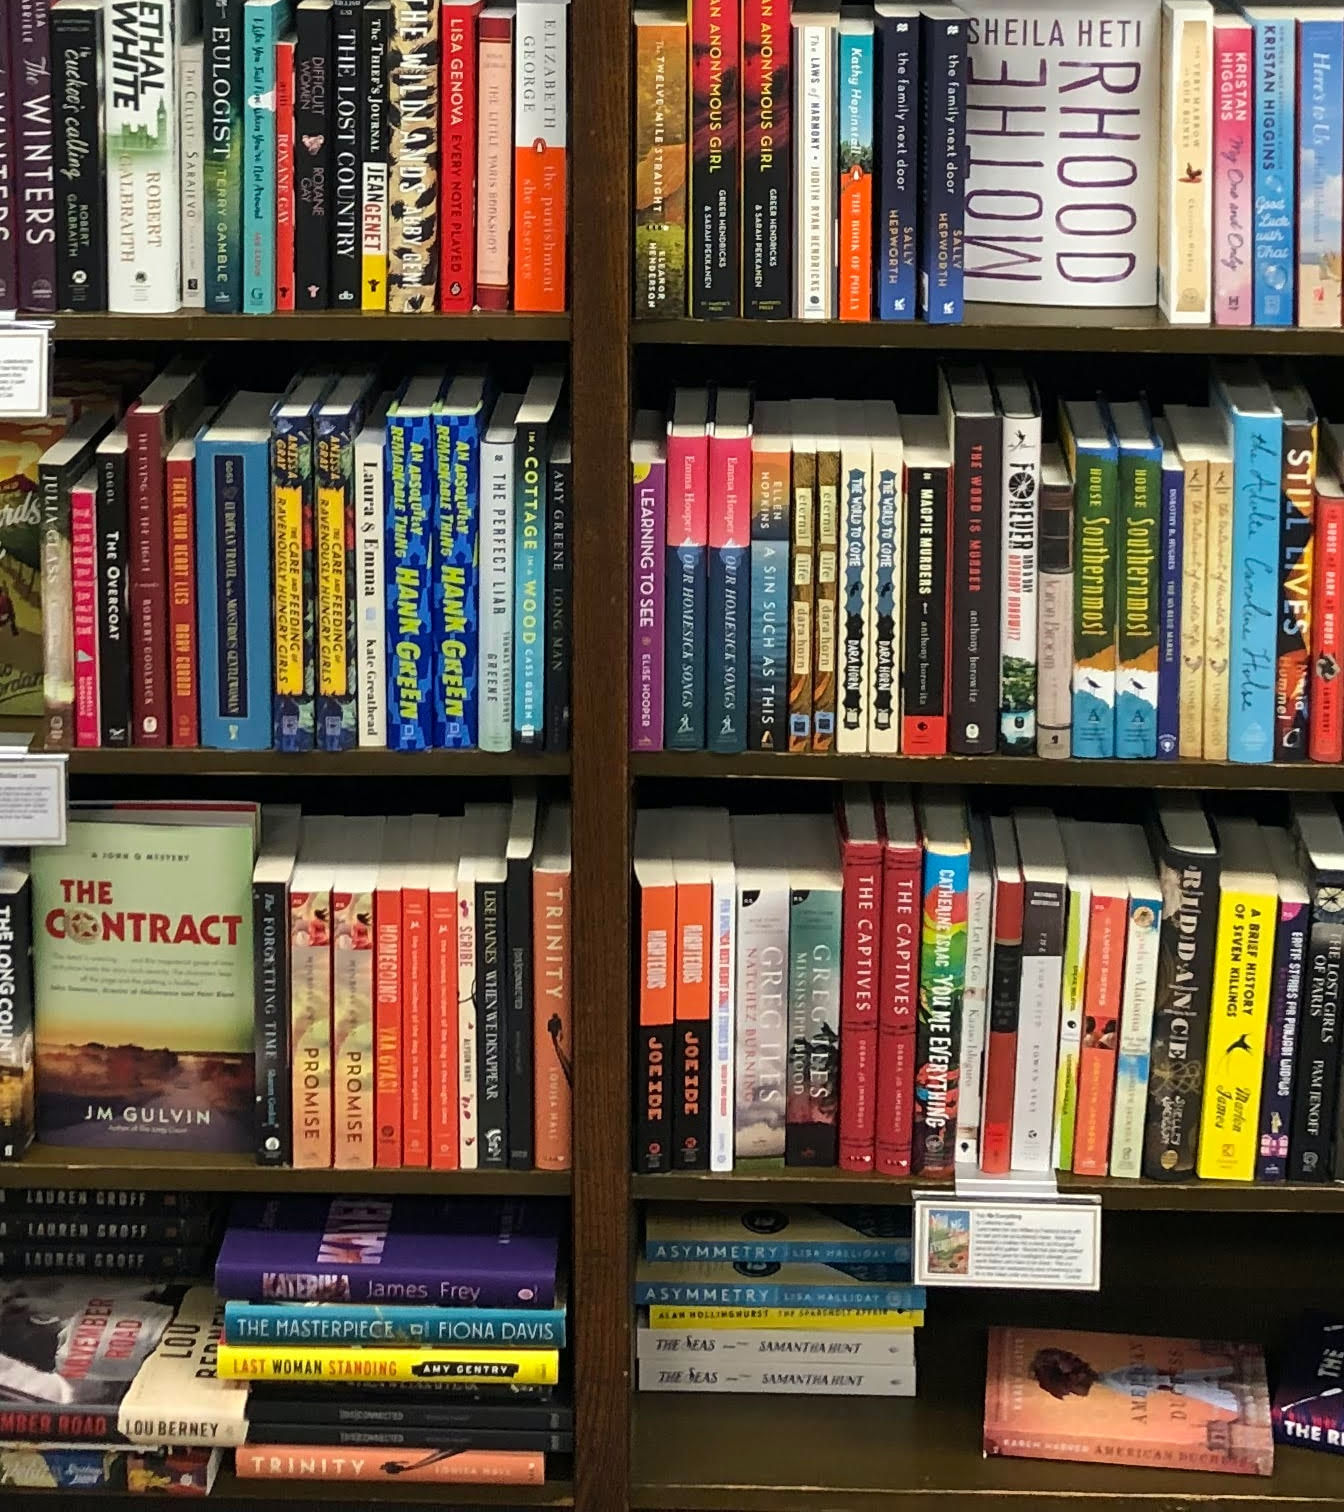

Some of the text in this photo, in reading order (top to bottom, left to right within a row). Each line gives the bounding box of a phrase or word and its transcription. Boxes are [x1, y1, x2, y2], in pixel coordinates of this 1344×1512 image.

[969, 17, 1141, 47] SHEILA HETI
[111, 2, 140, 111] WHITE
[919, 487, 933, 596] MAGPIE MURDERS
[441, 565, 468, 717] HANK GREEN
[84, 1105, 212, 1126] JM GULVIN
[367, 1280, 481, 1302] James Frey
[646, 1287, 769, 1304] ASYMMETRY
[238, 1319, 553, 1340] THE MASTERPIECE FIONA DAVIS
[233, 1359, 397, 1376] LAST WOMAN STANDING
